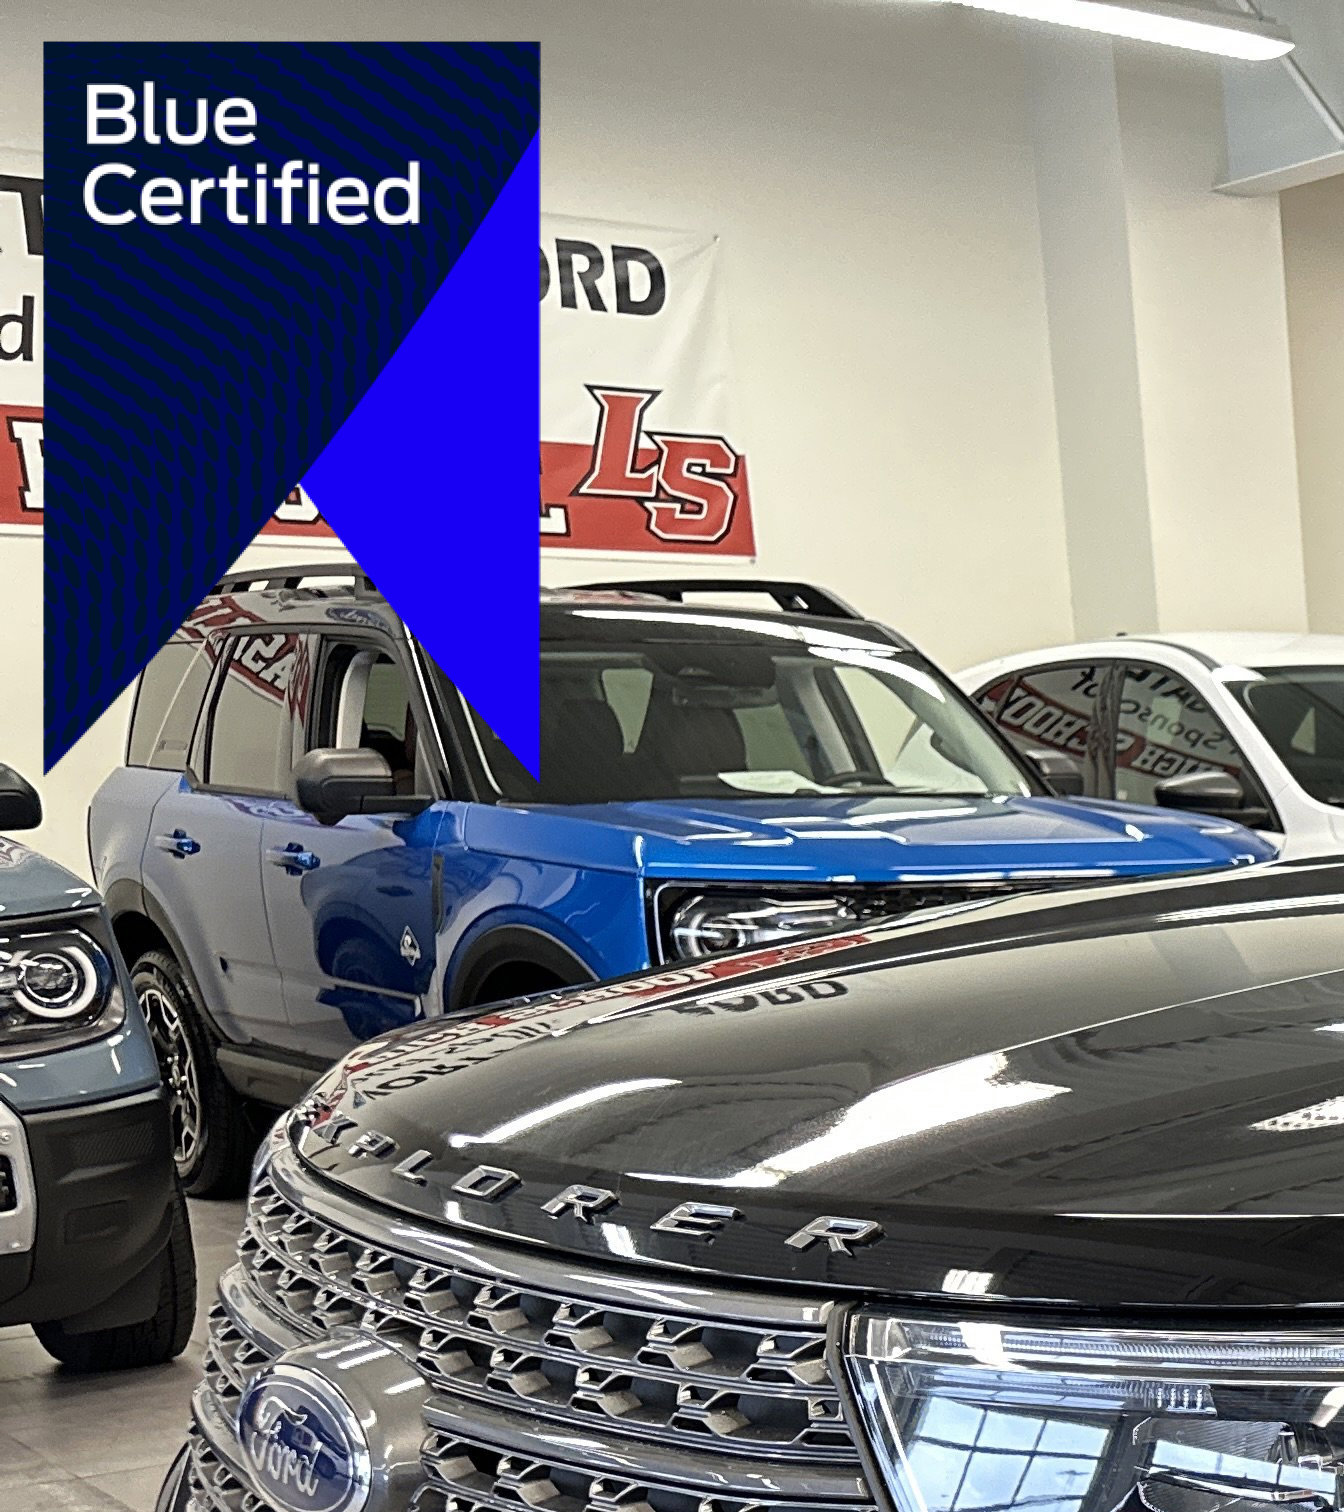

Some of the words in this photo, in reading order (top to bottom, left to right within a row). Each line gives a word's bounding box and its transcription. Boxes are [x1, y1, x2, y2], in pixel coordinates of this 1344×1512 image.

[540, 238, 666, 316] RD
[569, 383, 740, 545] LS
[302, 1098, 886, 1258] XPLORER
[250, 1394, 324, 1497] Ford
